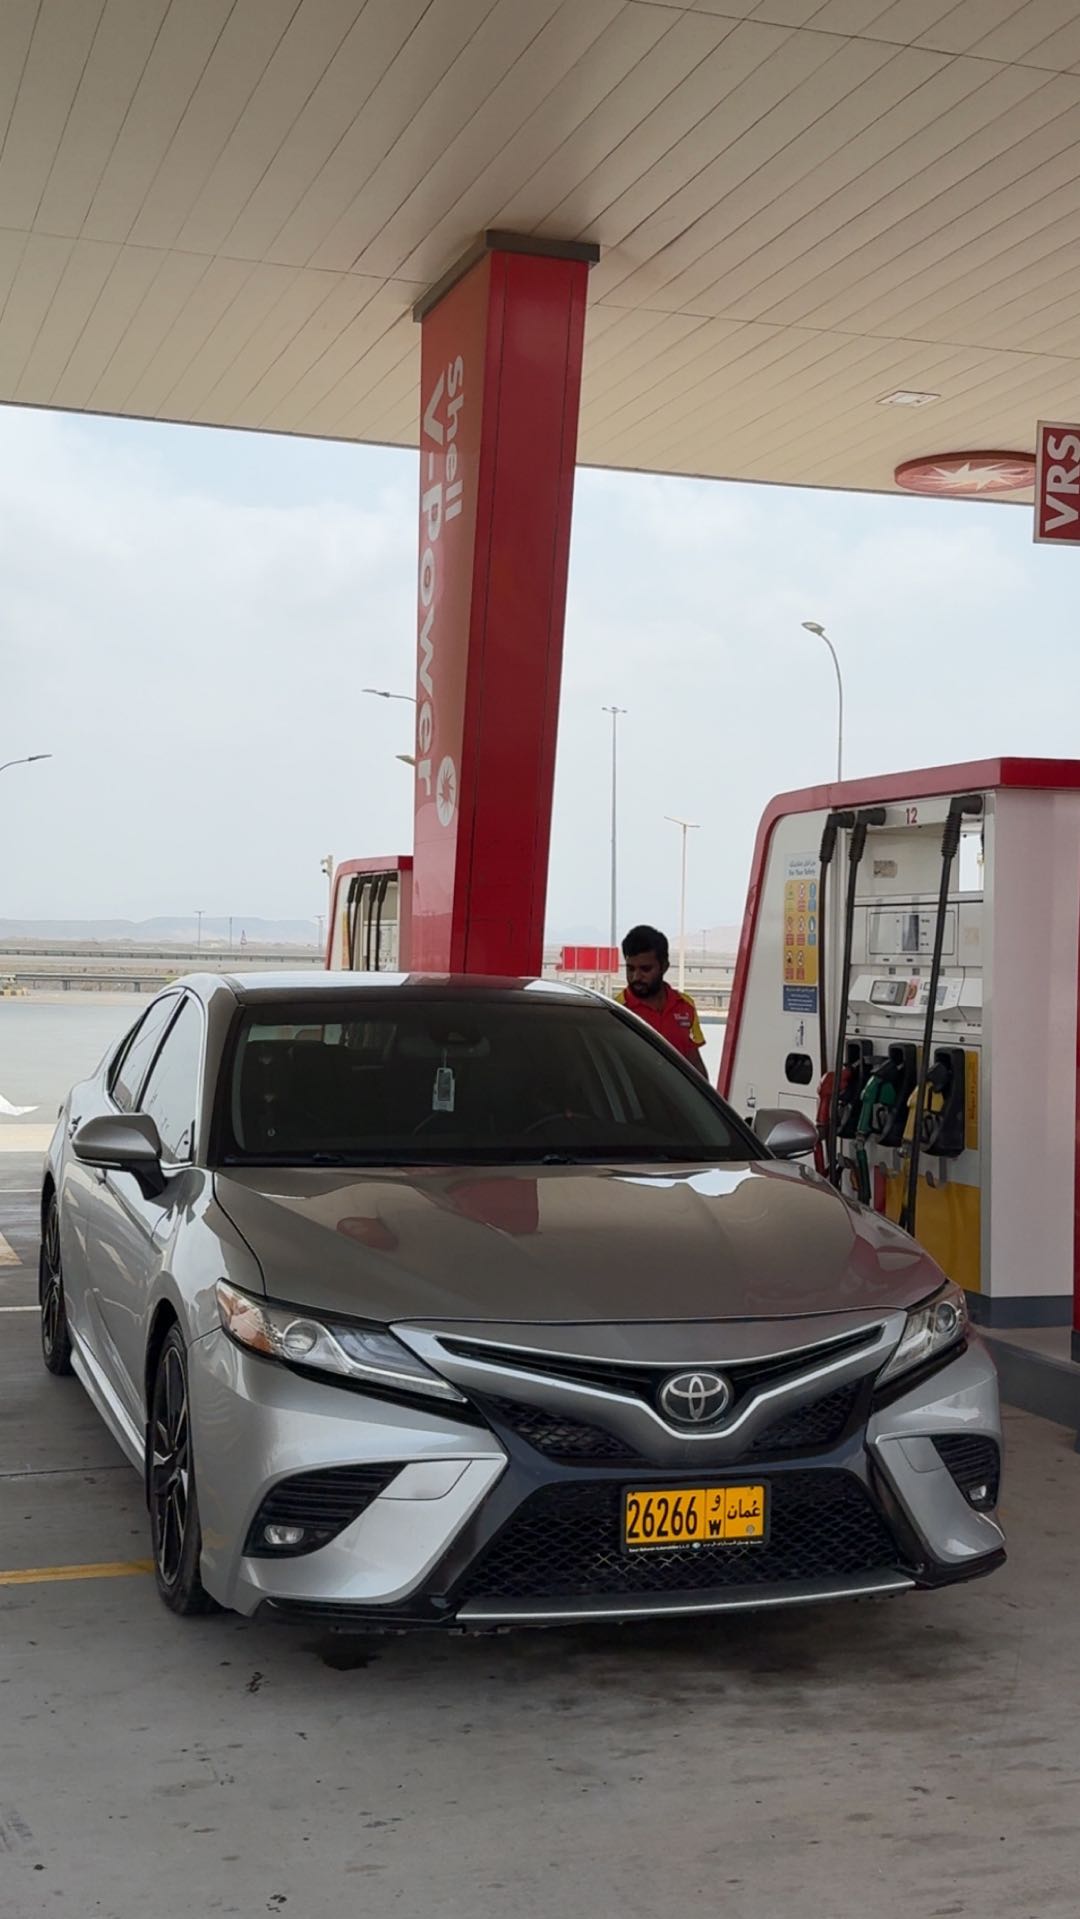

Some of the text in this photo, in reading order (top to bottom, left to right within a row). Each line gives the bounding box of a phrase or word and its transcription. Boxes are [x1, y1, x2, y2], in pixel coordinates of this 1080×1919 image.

[446, 355, 464, 522] Shell
[1045, 434, 1080, 532] VRS
[417, 369, 445, 796] V-Power
[906, 807, 918, 825] 12
[627, 1496, 698, 1539] 26266
[711, 1494, 721, 1511] و
[708, 1519, 722, 1536] W
